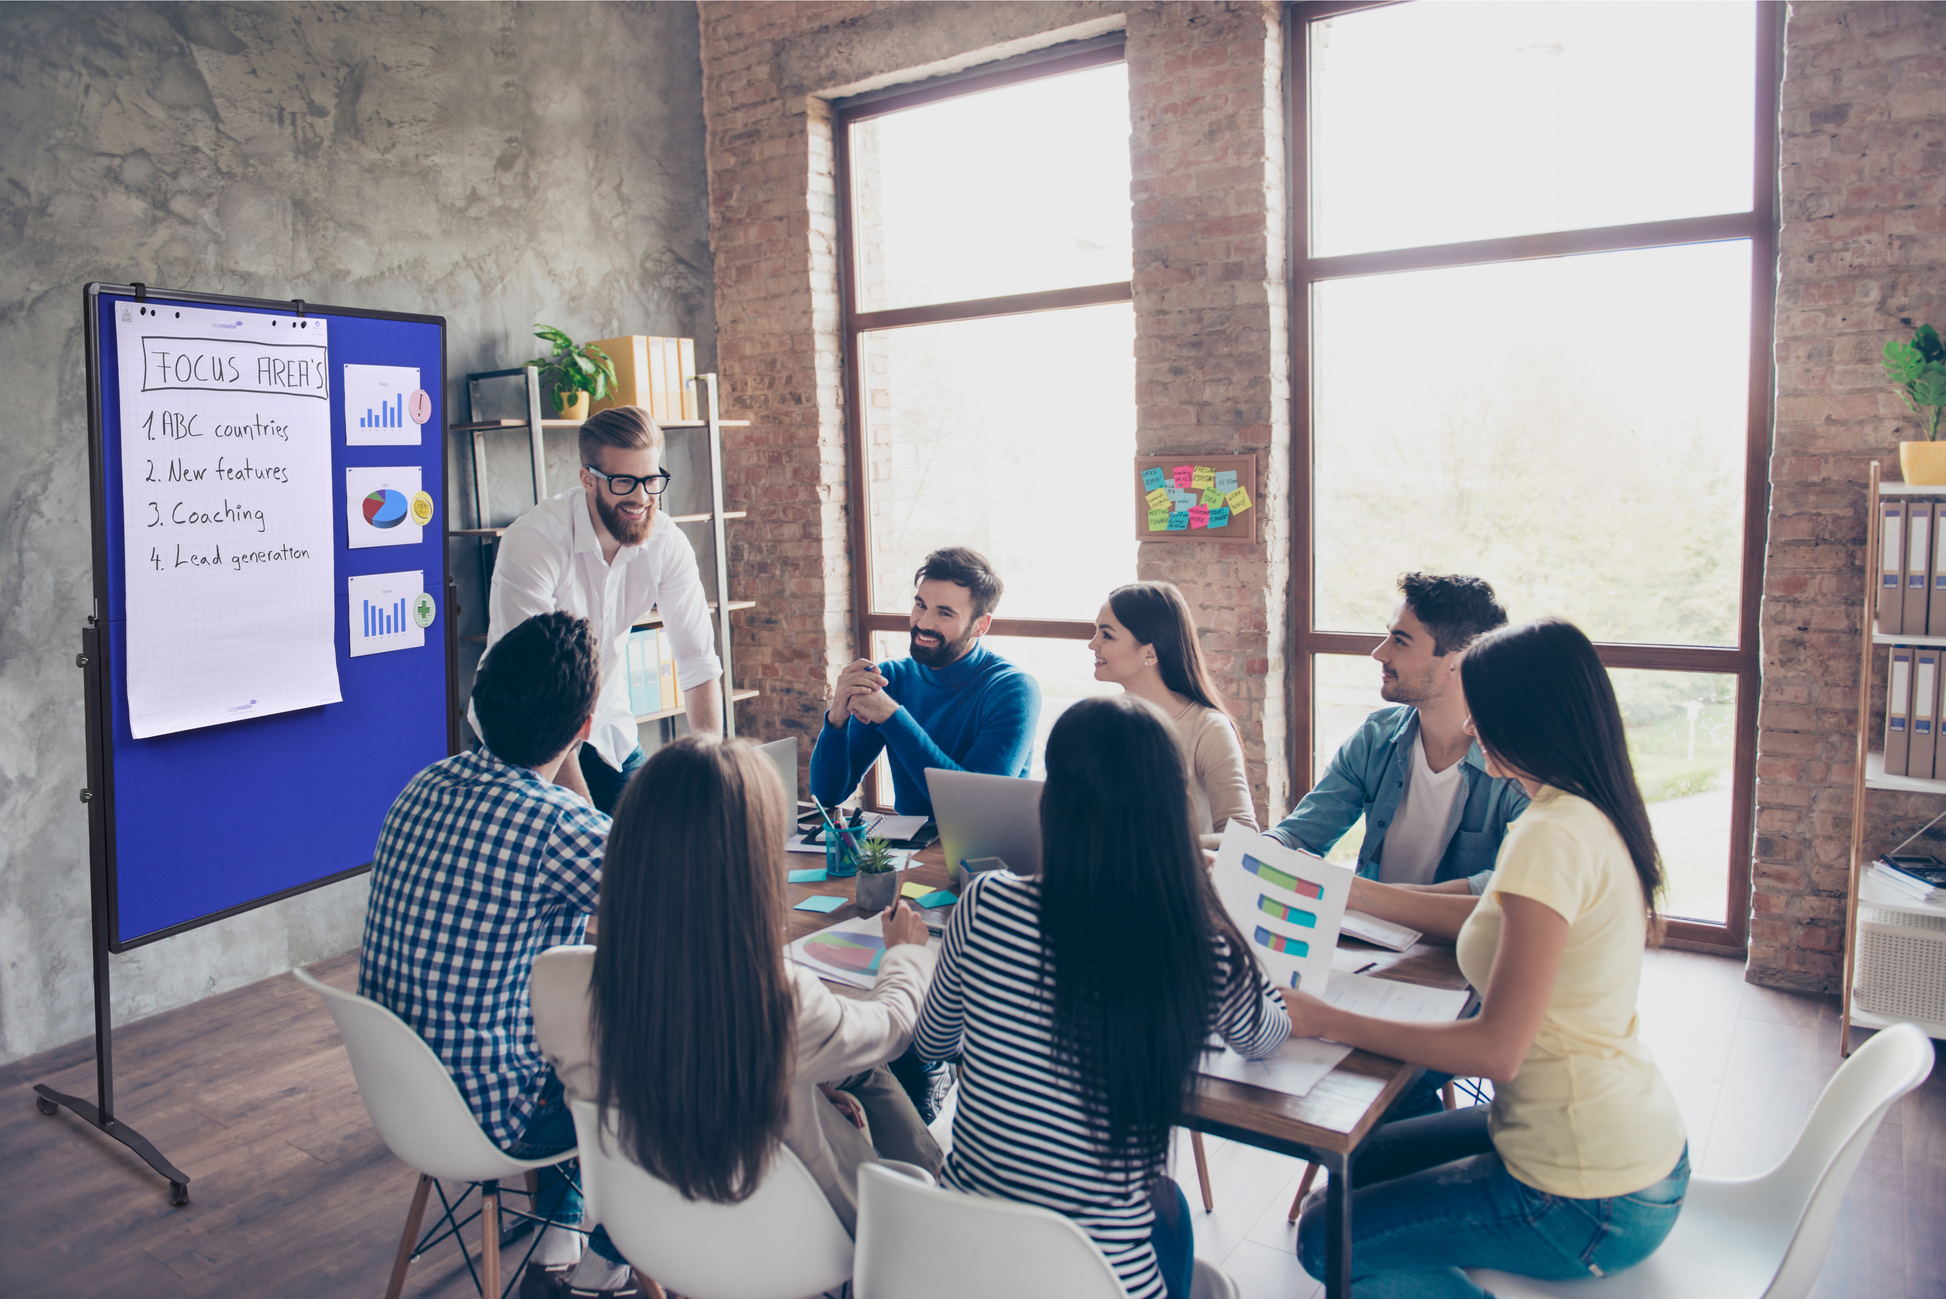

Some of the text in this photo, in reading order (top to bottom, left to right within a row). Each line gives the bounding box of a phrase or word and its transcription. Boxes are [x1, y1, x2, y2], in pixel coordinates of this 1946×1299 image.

[211, 321, 237, 330] Legamaster
[151, 351, 325, 389] FOCUS AREA'S
[142, 410, 289, 442] 1. ABC countries
[145, 456, 289, 484] 2. New features
[147, 499, 266, 533] 3. Coaching
[150, 544, 310, 571] 4. Lead generation
